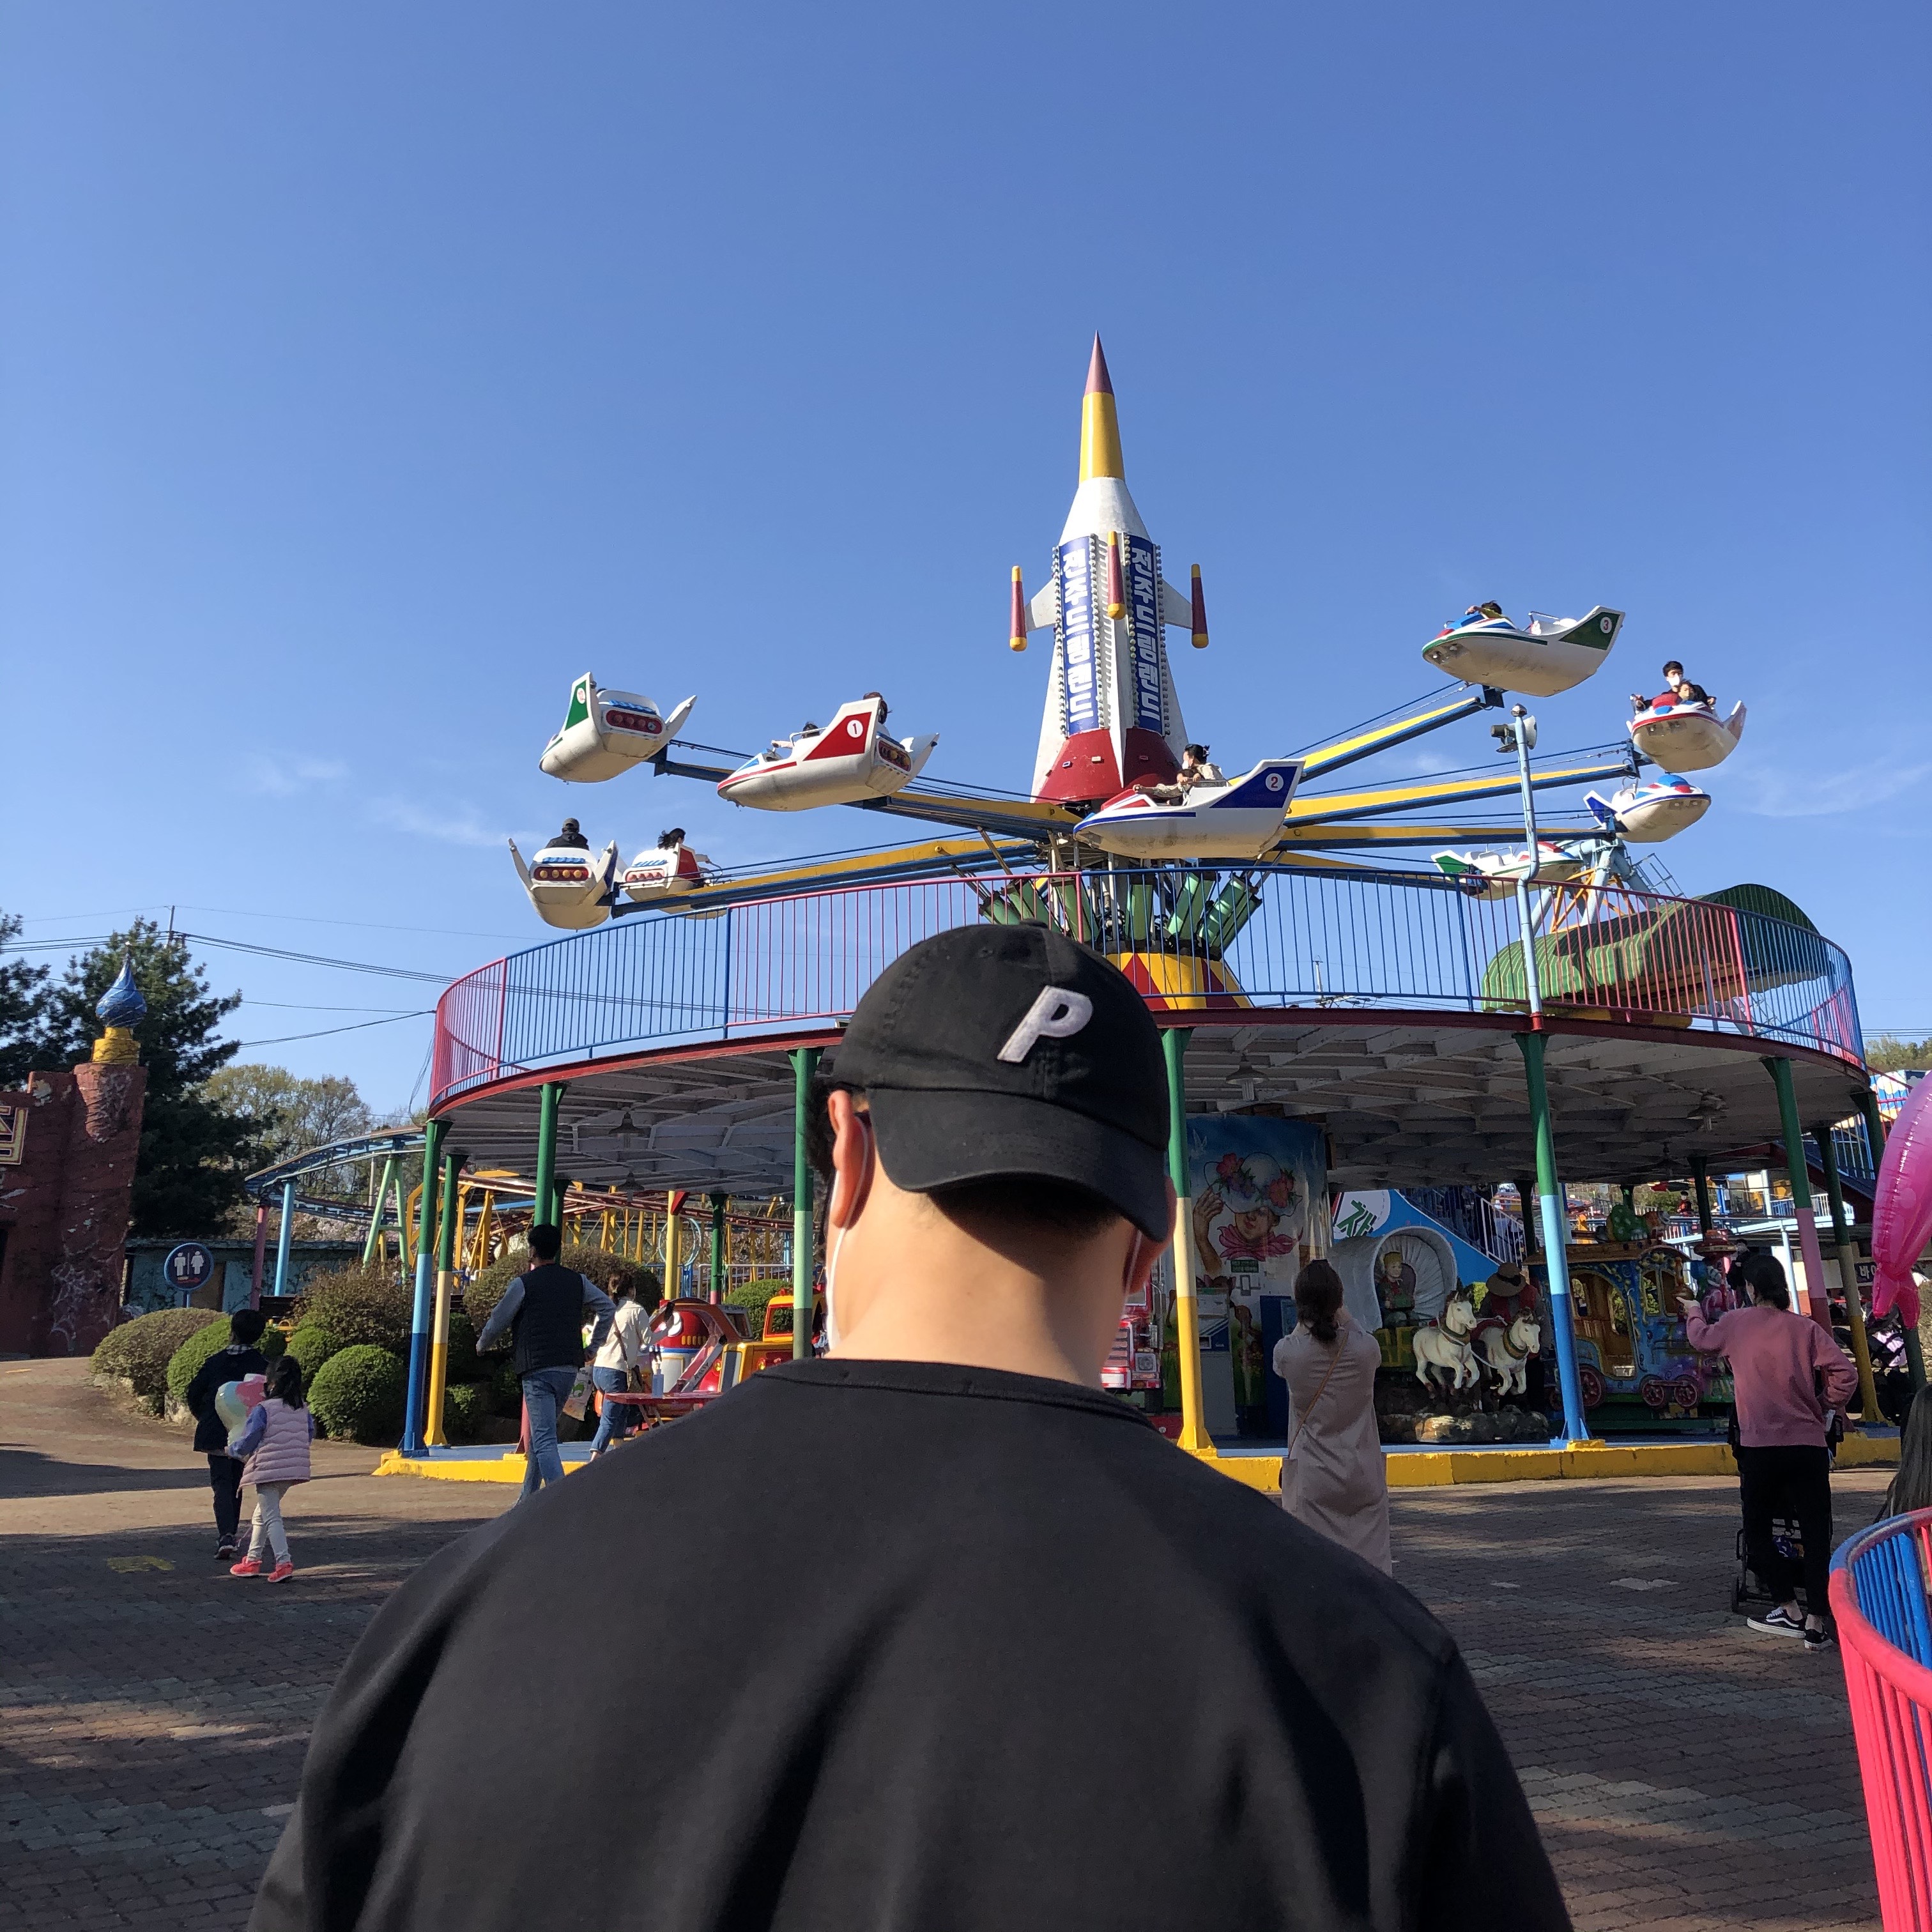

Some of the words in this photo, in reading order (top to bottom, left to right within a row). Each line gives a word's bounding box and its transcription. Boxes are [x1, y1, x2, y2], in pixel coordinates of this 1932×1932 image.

[1063, 548, 1094, 723] 전주드림랜드
[1131, 547, 1161, 721] 전주드림랜드
[1603, 619, 1609, 631] 3
[852, 723, 857, 735] 1
[1271, 776, 1278, 788] 2
[997, 985, 1094, 1063] P
